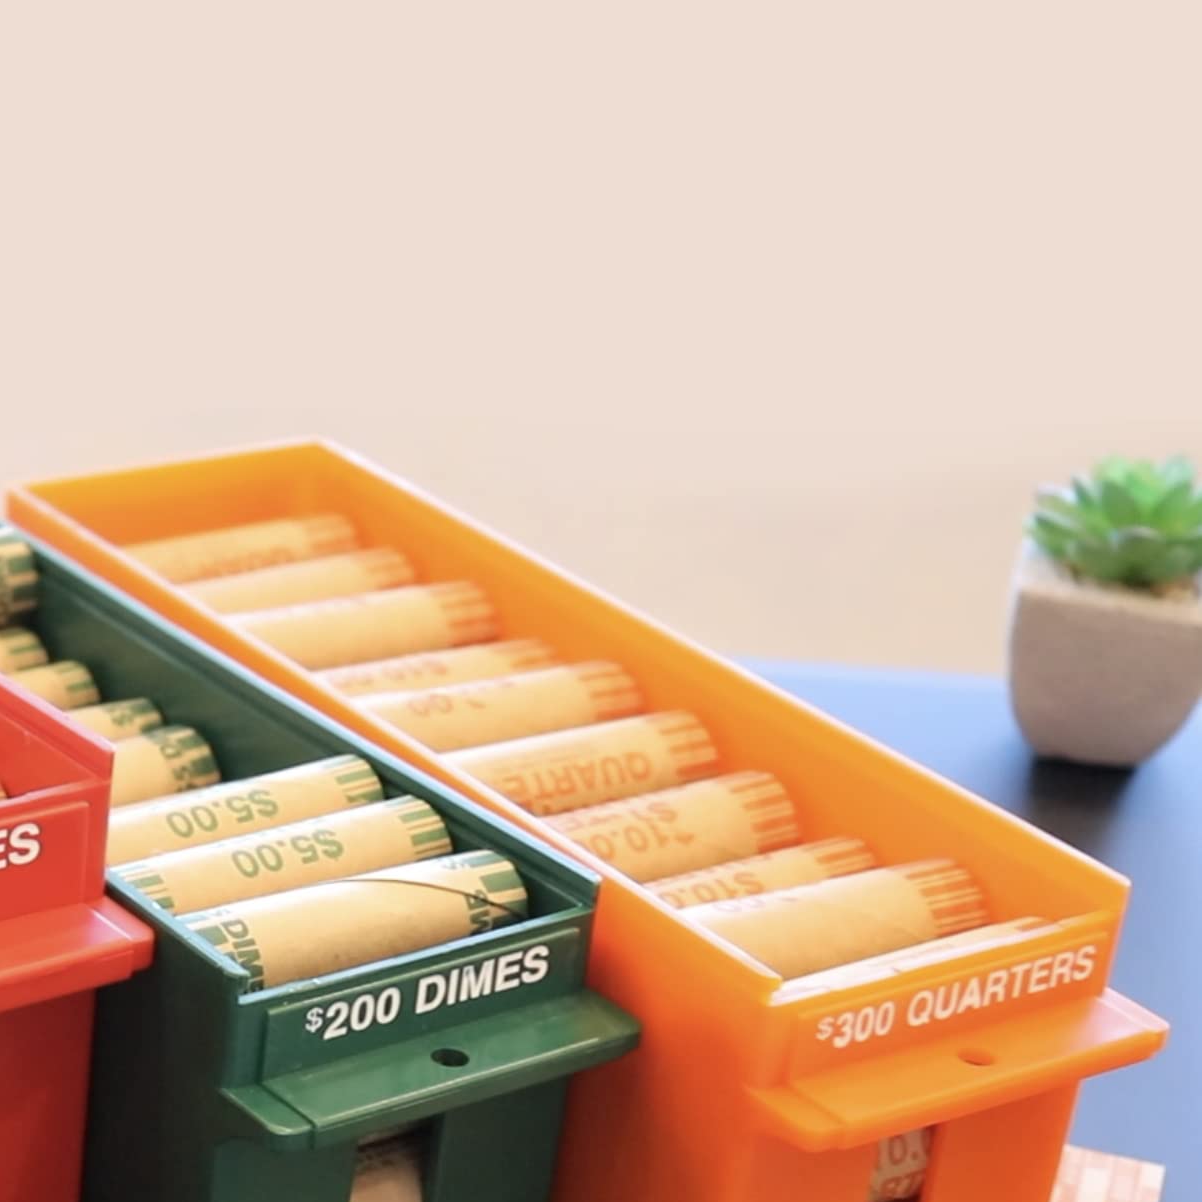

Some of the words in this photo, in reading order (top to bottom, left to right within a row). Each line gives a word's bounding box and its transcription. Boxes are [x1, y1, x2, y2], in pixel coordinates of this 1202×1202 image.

[305, 987, 400, 1040] $200
[415, 945, 550, 1015] DIMES
[815, 1000, 895, 1049] $300
[907, 945, 1097, 1027] QUARTERS
